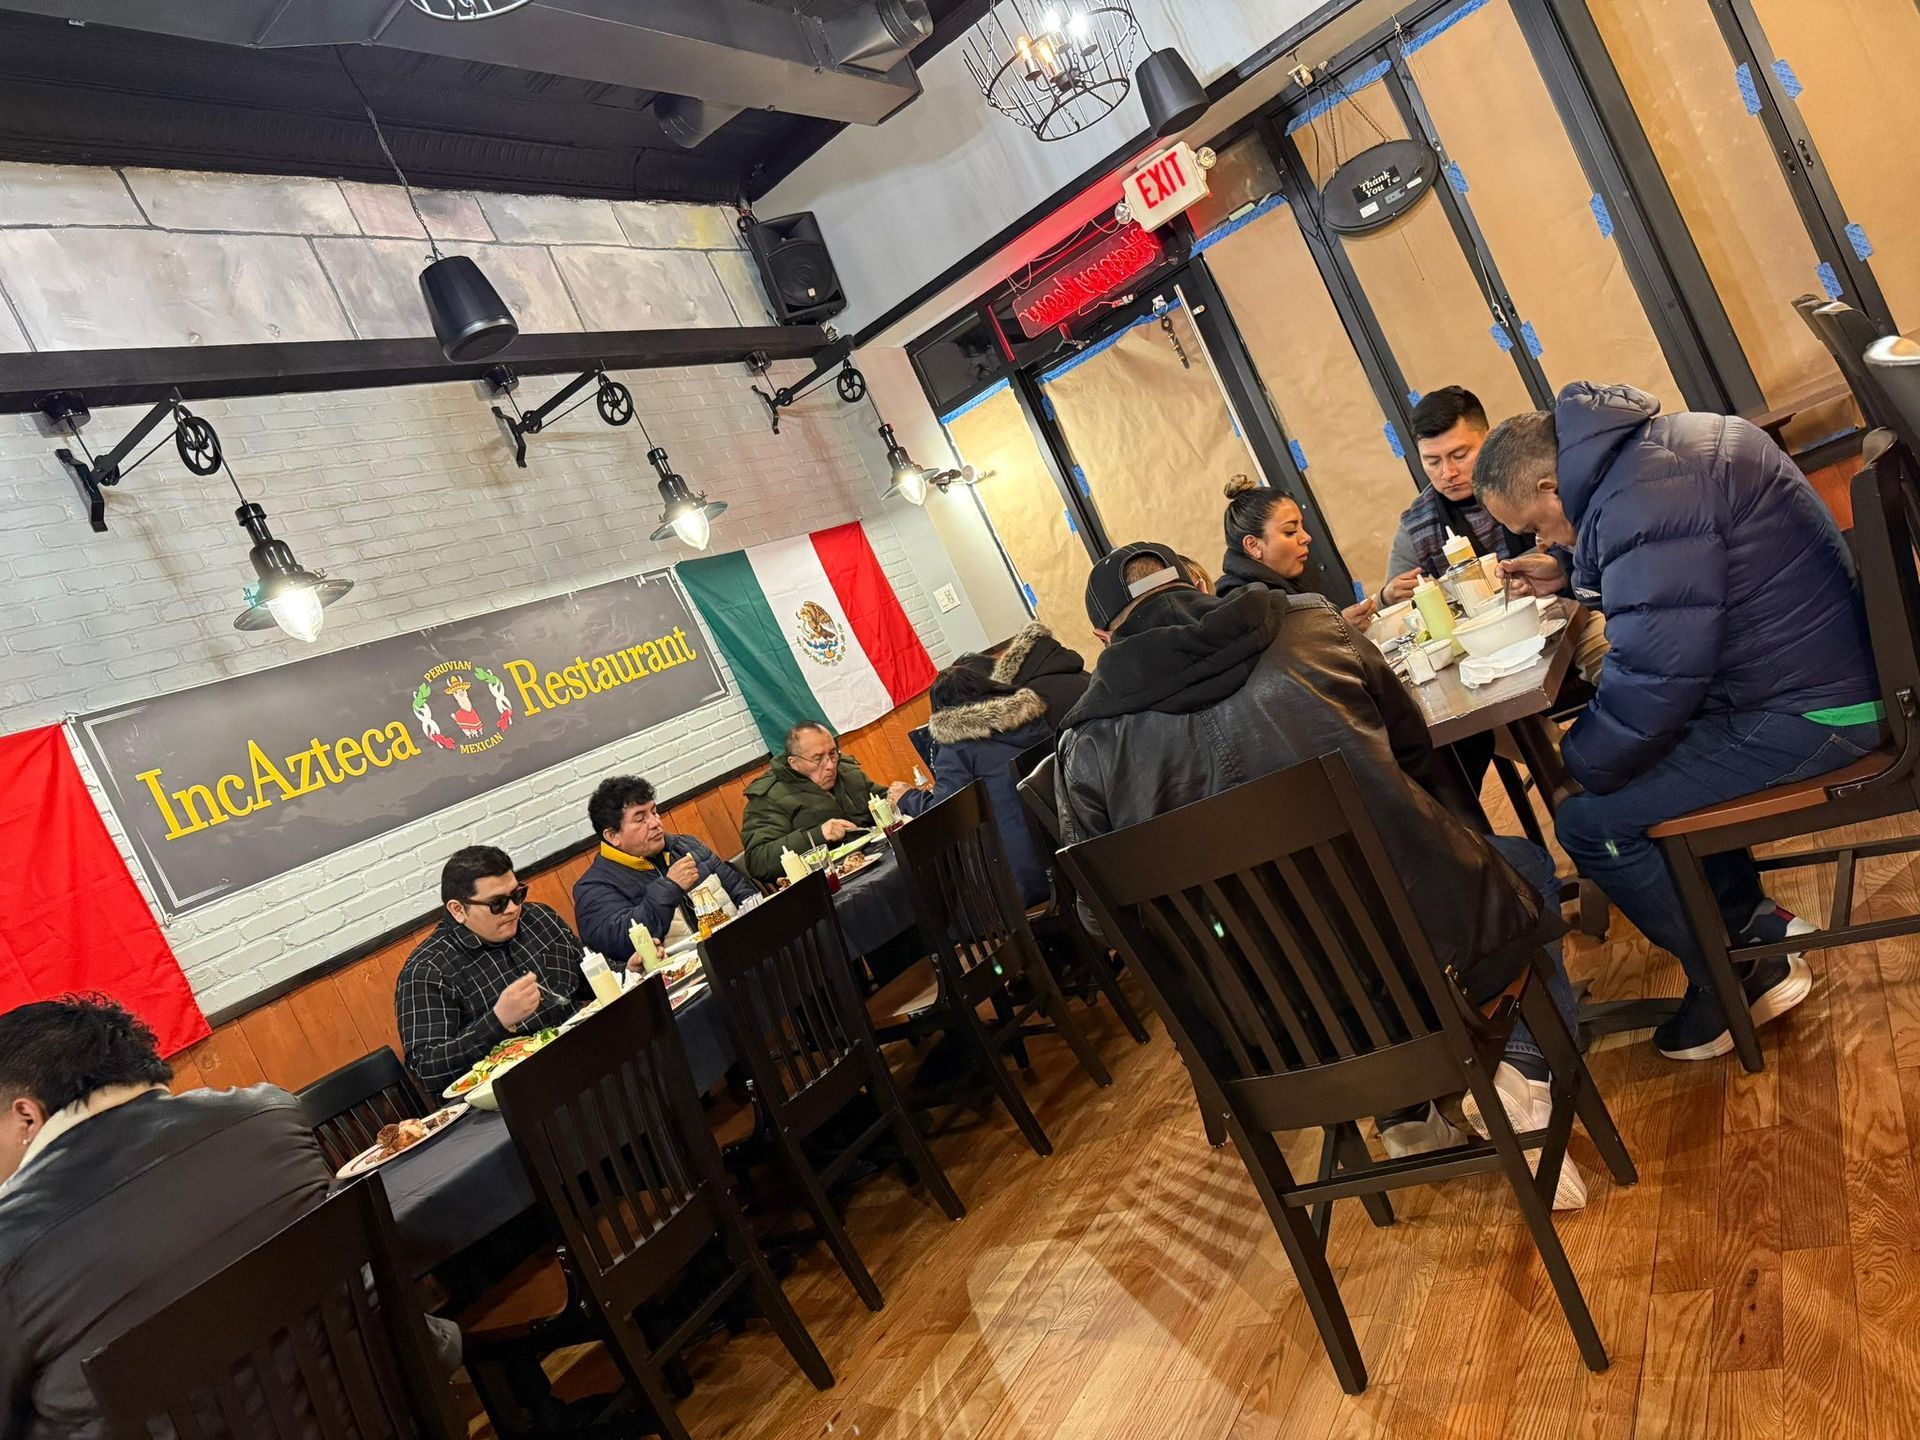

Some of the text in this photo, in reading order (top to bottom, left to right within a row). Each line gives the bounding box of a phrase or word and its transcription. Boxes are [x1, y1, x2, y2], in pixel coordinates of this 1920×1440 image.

[1135, 151, 1186, 209] EXIT
[1358, 171, 1391, 192] Thank
[424, 660, 472, 683] PERUVIAN
[135, 625, 698, 842] IncAzteca Restaurant
[460, 732, 504, 754] MEXICAN
